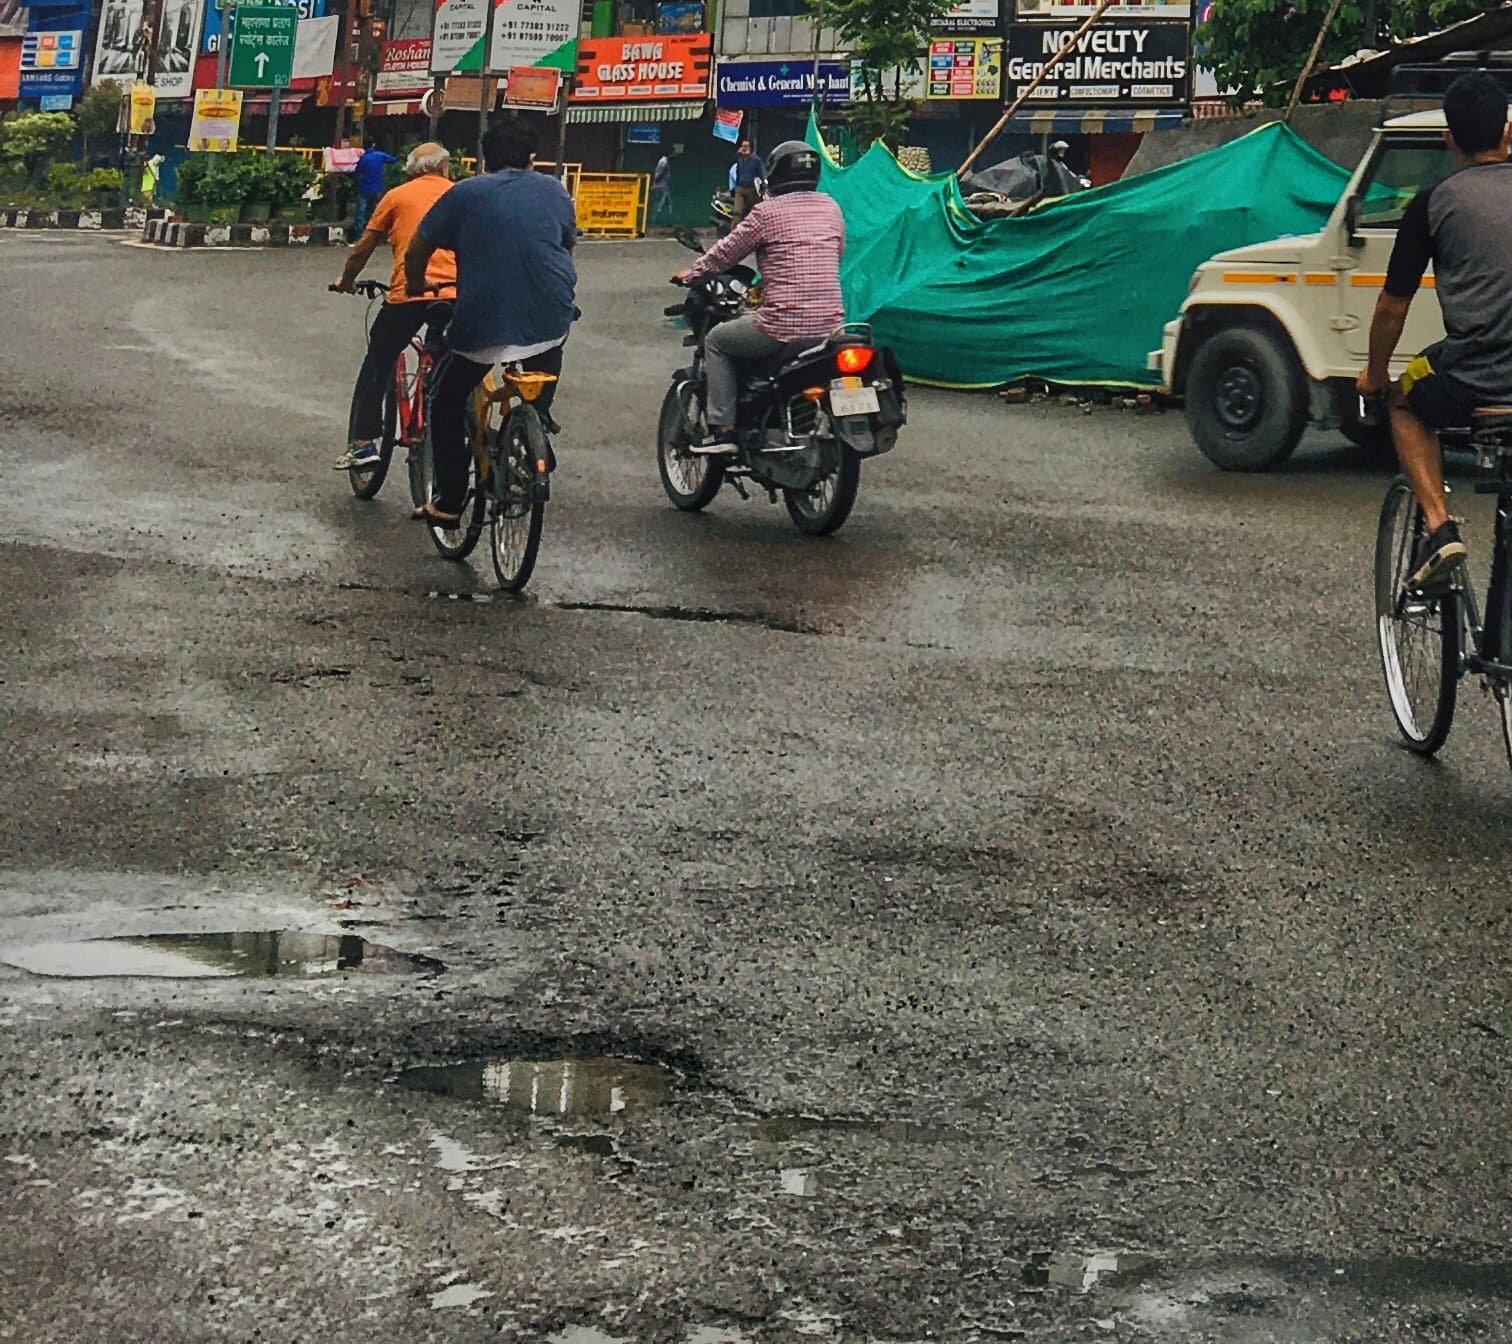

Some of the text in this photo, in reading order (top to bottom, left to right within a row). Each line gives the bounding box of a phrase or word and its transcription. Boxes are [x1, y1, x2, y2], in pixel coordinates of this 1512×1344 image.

[517, 3, 557, 12] CAPITAL
[1042, 29, 1149, 54] NOVELTY
[385, 43, 431, 62] Roshan
[621, 42, 664, 62] BAWA
[597, 61, 684, 83] GLASS HOUSE
[1008, 56, 1186, 80] General Merchants
[160, 76, 183, 87] SHOP
[720, 76, 757, 92] Chemist
[757, 77, 767, 91] &
[768, 74, 804, 92] General
[806, 73, 850, 90] Merhant
[1133, 85, 1171, 95] COSMETICS
